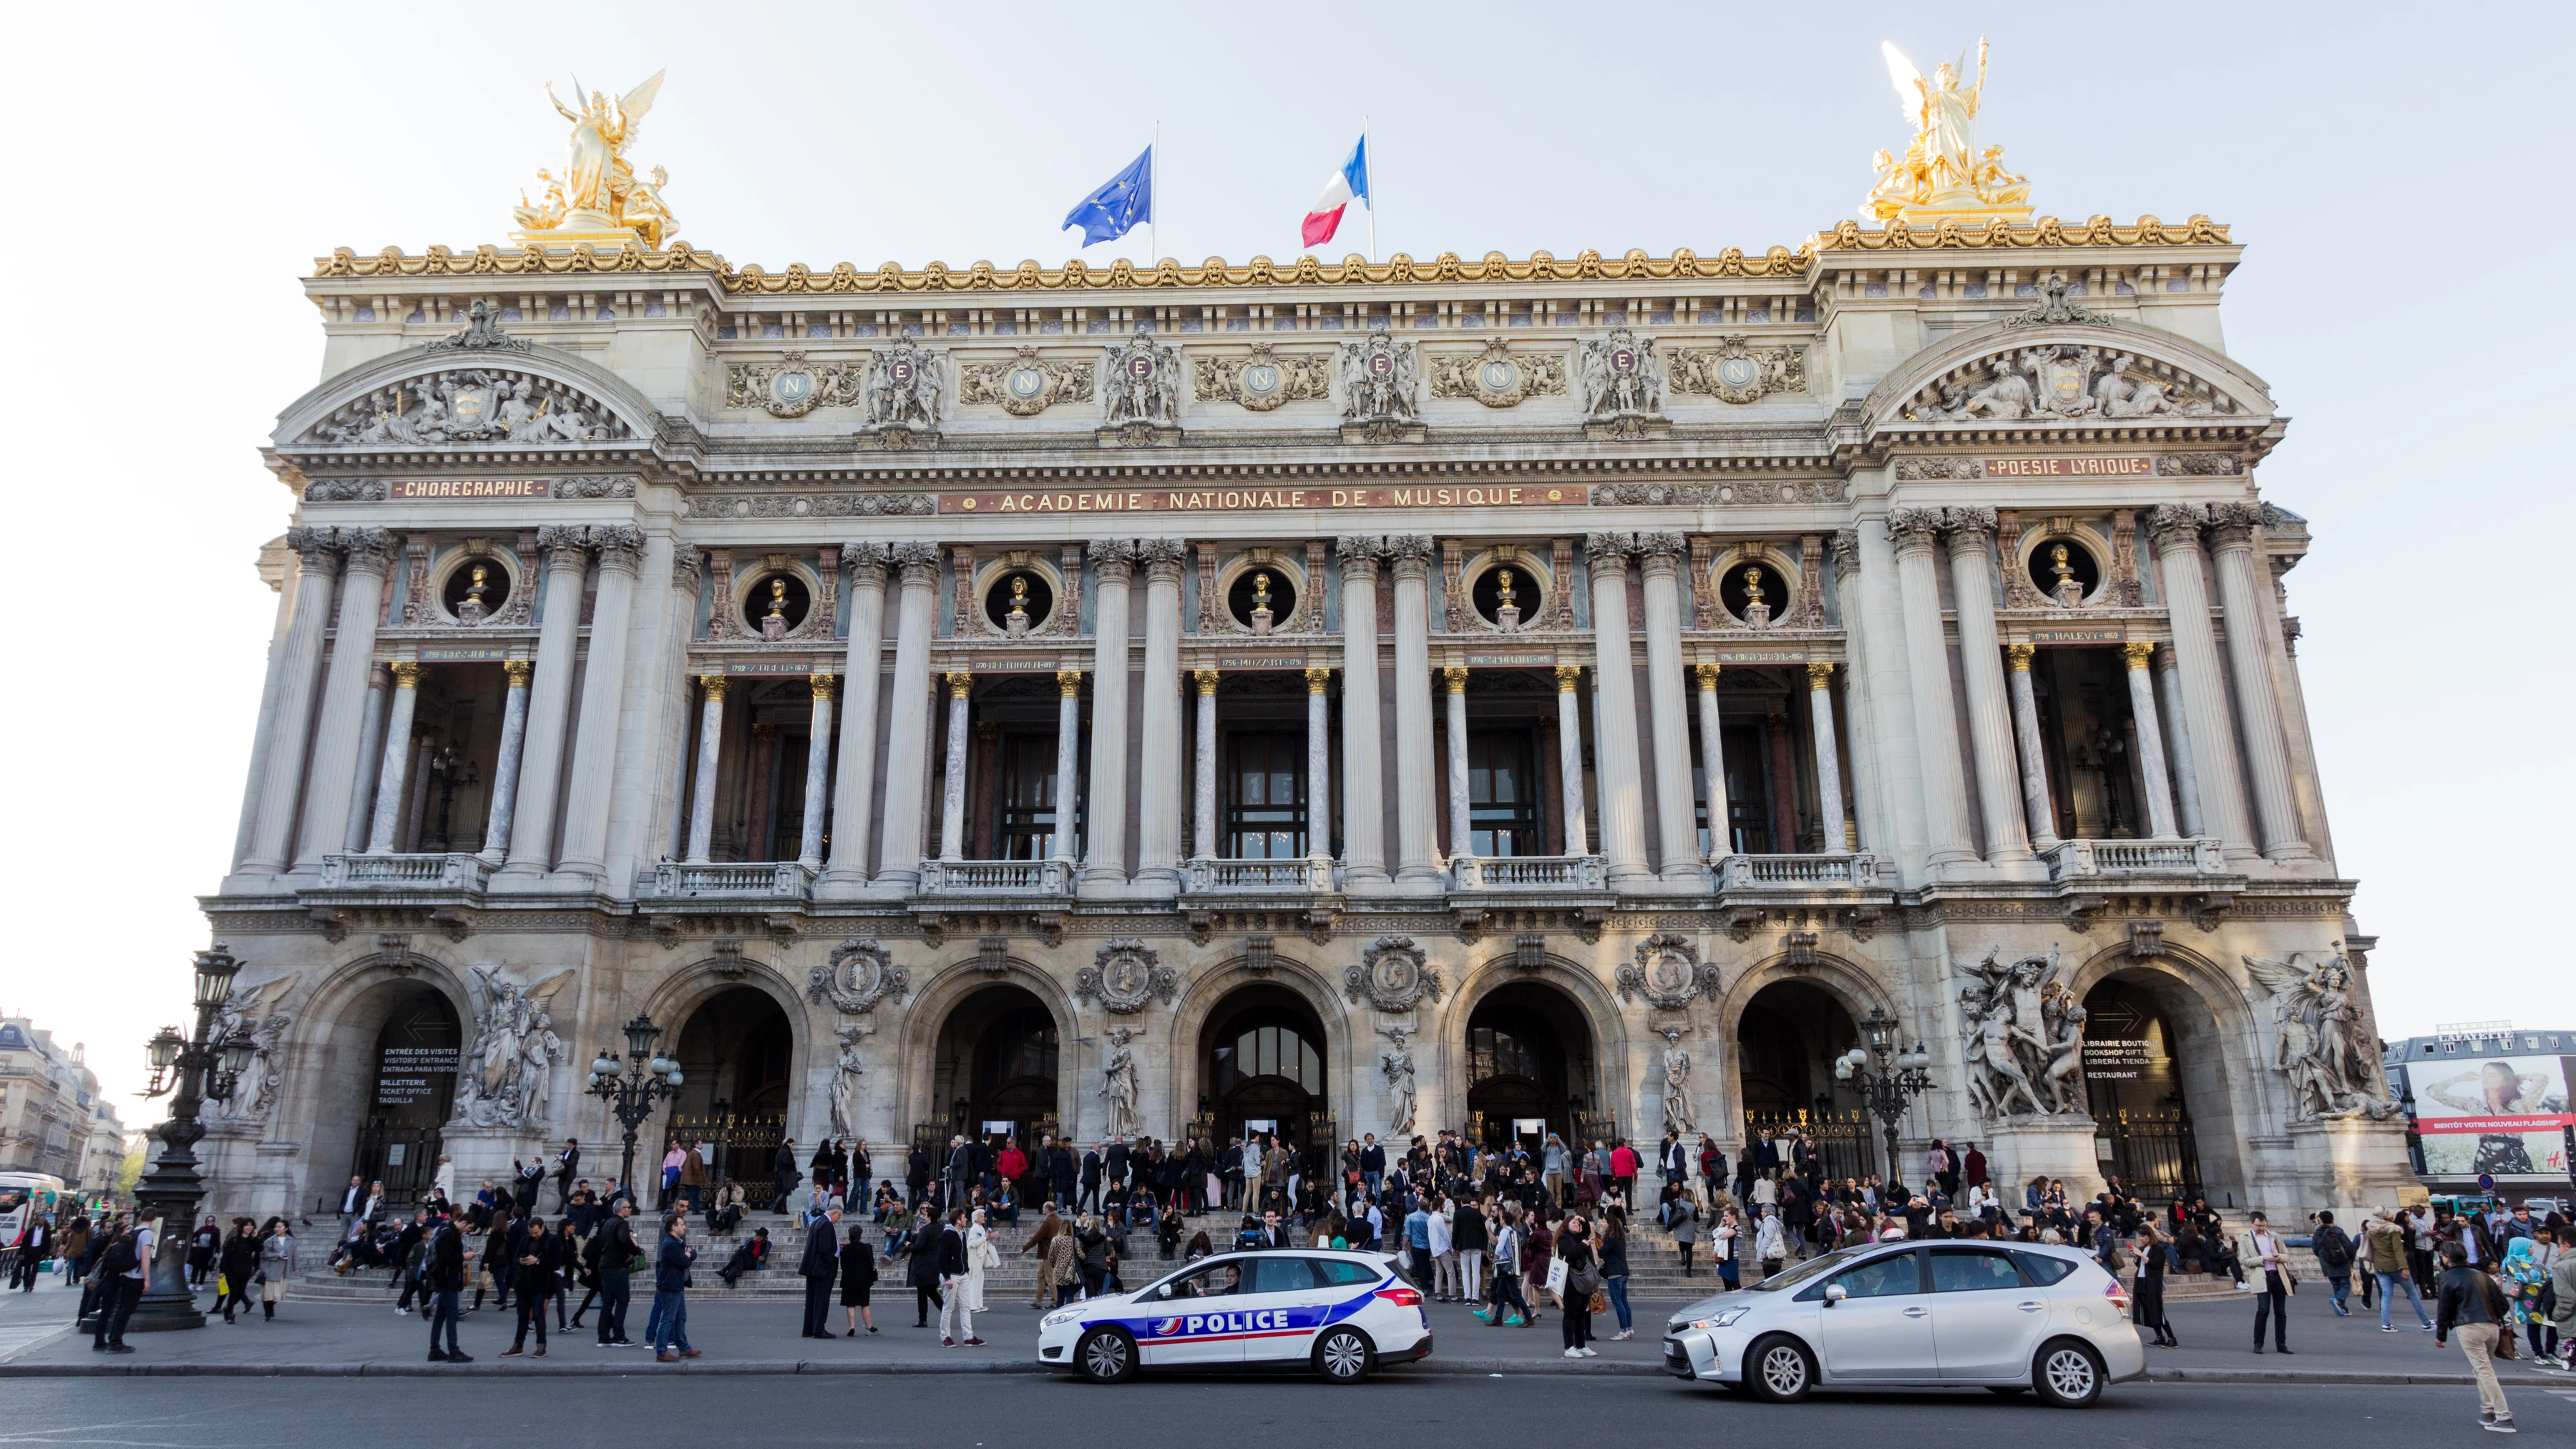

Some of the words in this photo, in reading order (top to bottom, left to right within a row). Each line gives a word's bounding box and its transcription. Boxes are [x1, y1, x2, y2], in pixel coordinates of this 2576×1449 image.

[1375, 358, 1385, 371] E
[1617, 353, 1629, 366] E
[896, 365, 907, 378] E
[1135, 361, 1145, 374] E
[1492, 367, 1506, 381] N
[1730, 364, 1745, 379] N
[1019, 374, 1035, 390] N
[1254, 371, 1269, 385] N
[785, 379, 801, 394] N
[1997, 459, 2061, 475] POESIE
[2070, 459, 2141, 475] LYRIQUE
[405, 481, 533, 496] CHOREGRAPHIE
[1000, 493, 1142, 512] ACADEMIE
[1169, 491, 1305, 509] NATIONALE
[1332, 489, 1367, 507] DE
[1395, 488, 1523, 506] MUSIQUE
[2054, 632, 2097, 640] HALEVY
[2439, 1030, 2513, 1042] LAFAYETTE
[1187, 1309, 1289, 1333] POLICE
